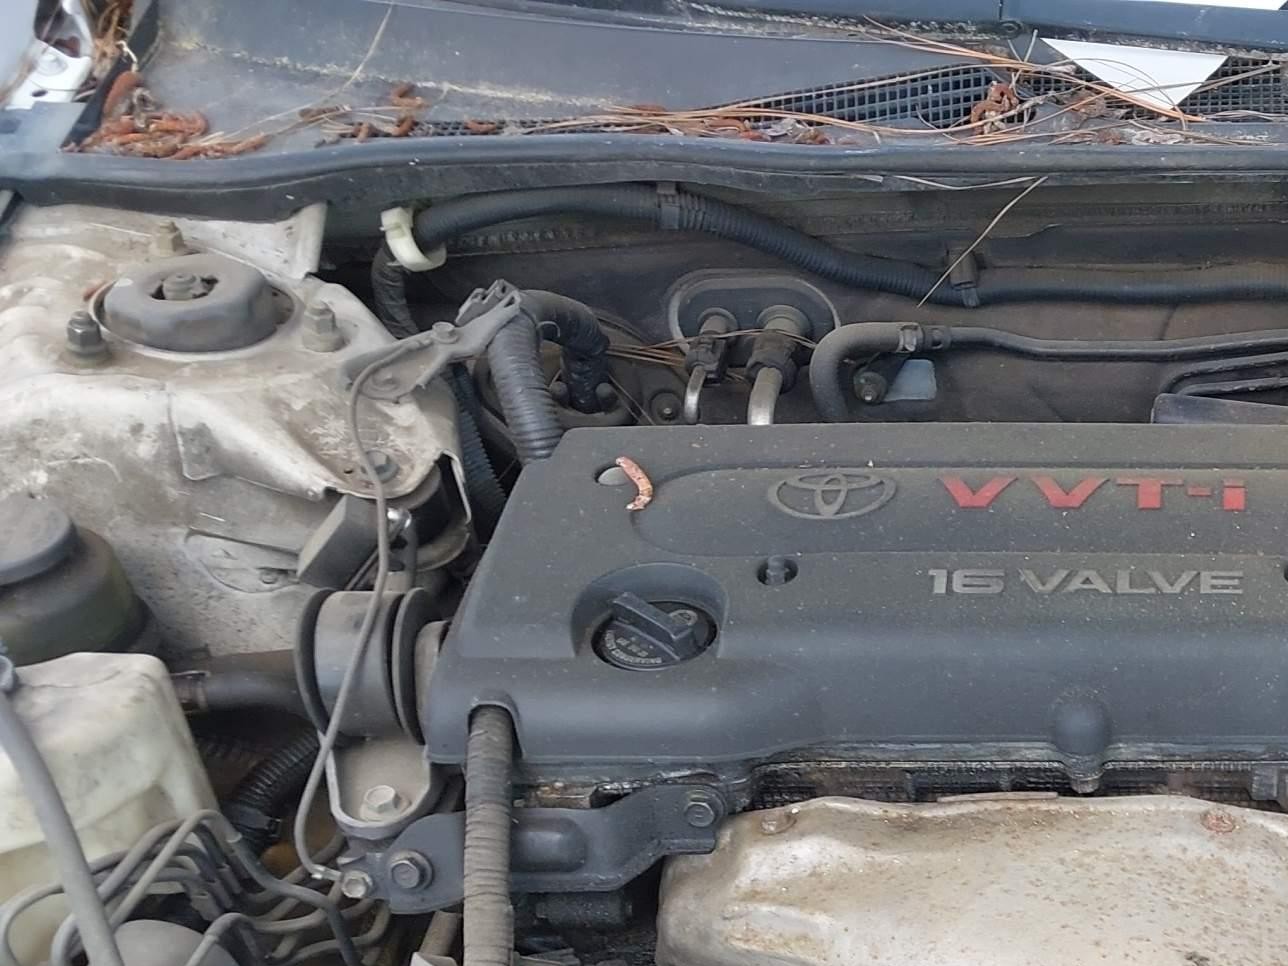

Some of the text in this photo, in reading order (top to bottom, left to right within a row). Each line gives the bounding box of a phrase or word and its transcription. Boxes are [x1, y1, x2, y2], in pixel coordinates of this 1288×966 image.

[938, 476, 1246, 511] VVT-i
[928, 567, 1244, 595] 16 VALVE
